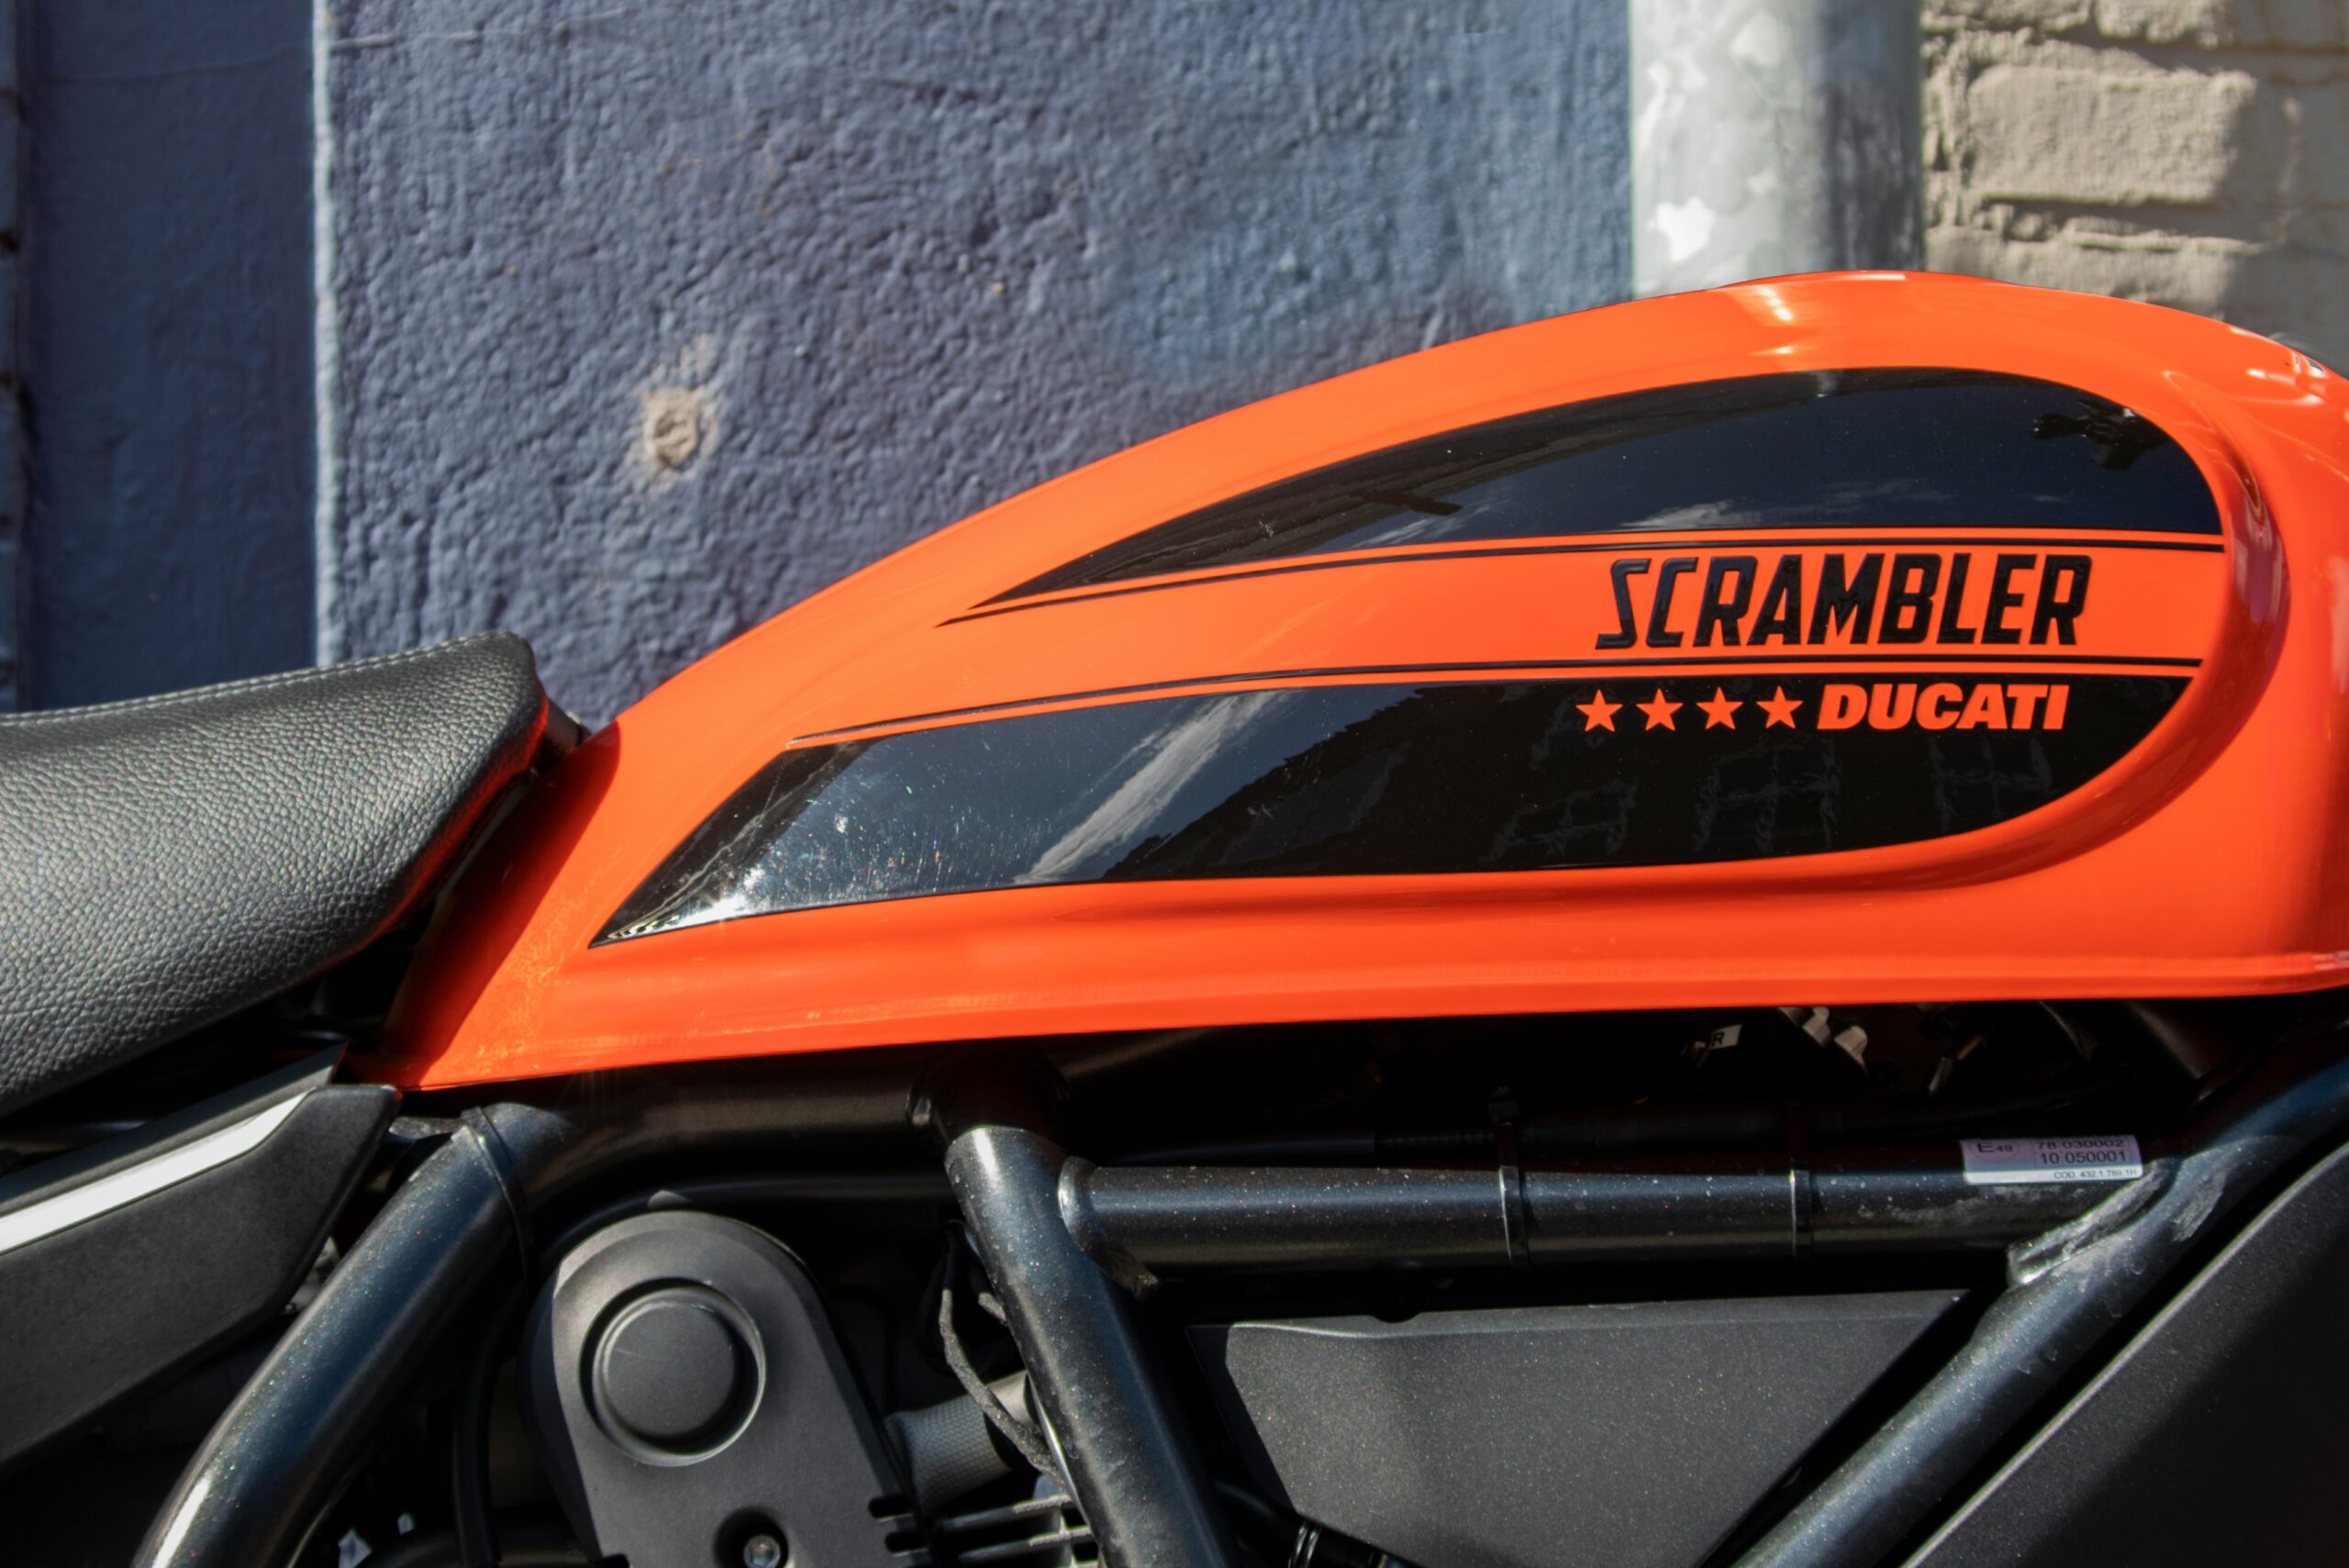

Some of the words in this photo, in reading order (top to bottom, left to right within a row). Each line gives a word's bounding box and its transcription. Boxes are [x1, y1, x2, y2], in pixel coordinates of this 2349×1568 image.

[1595, 552, 2093, 651] SCRAMBLER
[1817, 682, 2070, 730] DUCATI
[1711, 1031, 1725, 1048] R
[2040, 1152, 2060, 1164] 10
[2065, 1151, 2127, 1164] 050001
